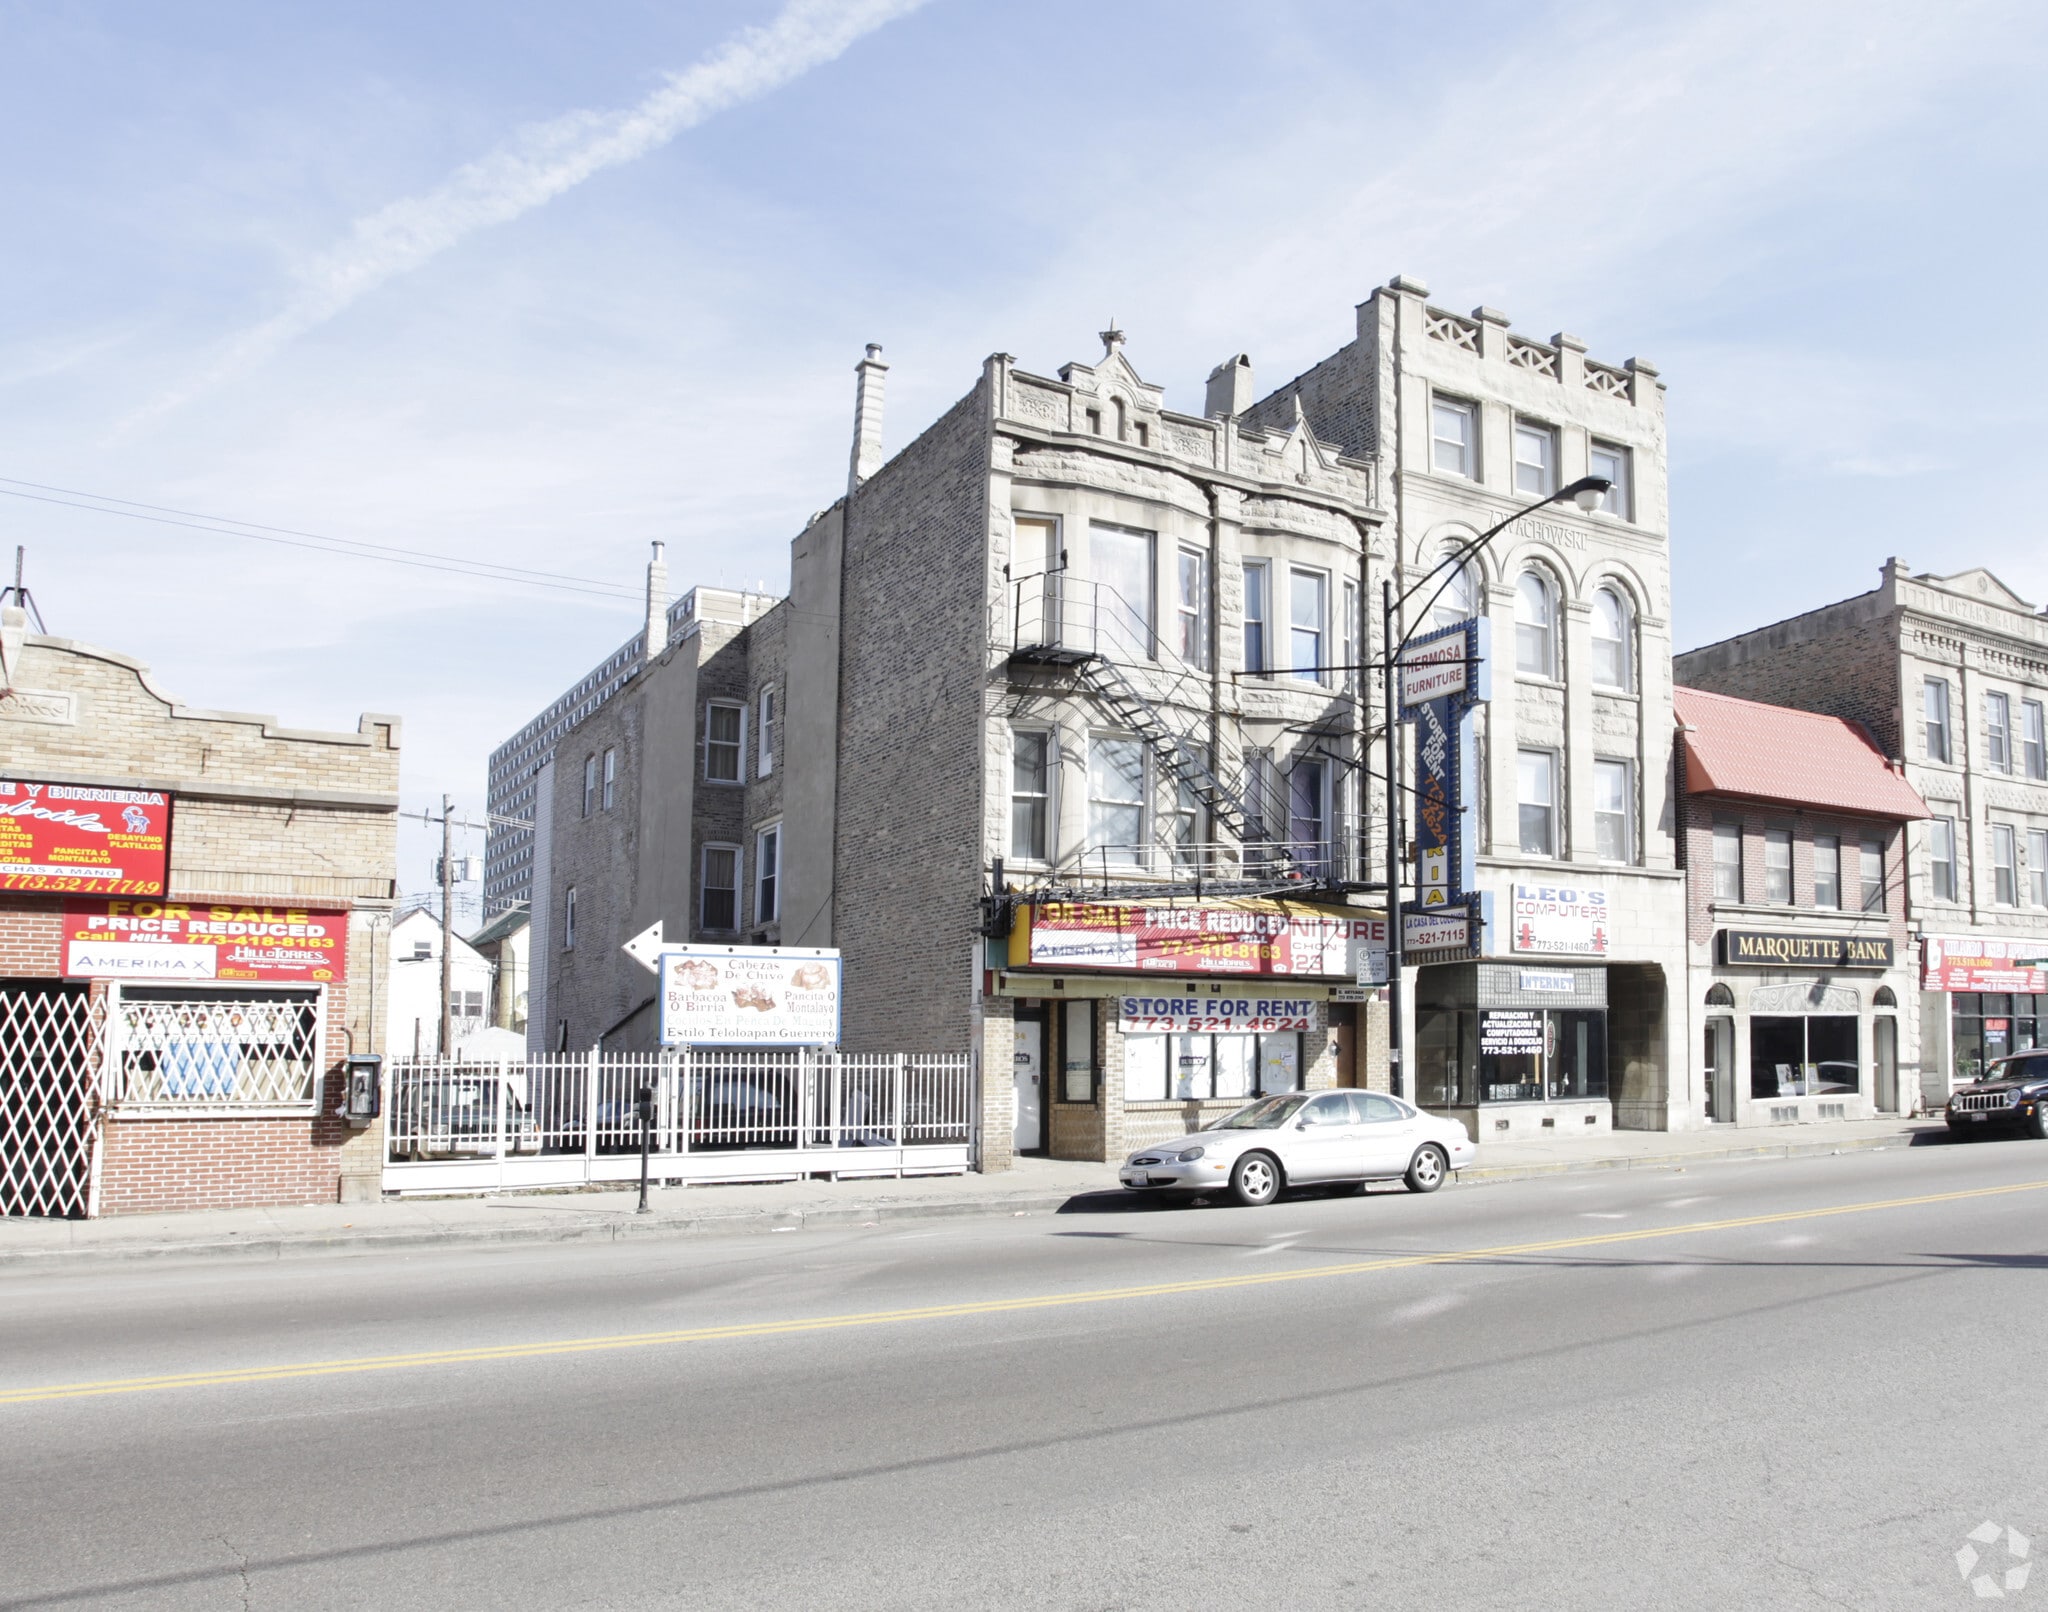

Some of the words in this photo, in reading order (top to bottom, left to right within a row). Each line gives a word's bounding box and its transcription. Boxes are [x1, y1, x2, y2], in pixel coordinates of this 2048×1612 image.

[1407, 645, 1461, 674] HERMOSA
[1407, 668, 1462, 696] FURNITURE
[1421, 702, 1447, 744] STORE
[1426, 735, 1445, 764] FOR
[1420, 746, 1445, 780] RENT
[24, 784, 44, 797] Y
[48, 786, 164, 805] BIRRIERIA
[107, 833, 162, 843] DESAYUNO
[110, 841, 164, 850] PLATILLOS
[48, 855, 111, 864] MONTALAYO
[54, 847, 98, 856] PANCITA
[4, 874, 160, 895] 773.521.7749
[1518, 886, 1605, 905] LEO'S
[108, 901, 191, 920] FOR
[208, 905, 309, 925] SALE
[1516, 902, 1607, 919] COMPUTERS
[88, 917, 180, 932] PRICE
[188, 921, 326, 937] REDUCED
[1082, 905, 1131, 926] SALE
[1144, 908, 1201, 930] PRICE
[1207, 912, 1289, 935] REDUCED
[1413, 916, 1428, 928] CASA
[75, 931, 116, 941] Call
[129, 933, 172, 943] HILL
[186, 934, 334, 948] 773-418-8163
[1036, 945, 1132, 962] AMERIMAX
[1160, 940, 1281, 959] 773-418-8163
[1739, 937, 1840, 962] MARQUETTE
[1846, 941, 1887, 960] BANK
[76, 956, 211, 975] AMERIMAX
[729, 959, 780, 970] Cabezas
[725, 971, 741, 979] De
[747, 970, 784, 980] Chivo
[1521, 976, 1573, 991] INTERNET
[668, 991, 727, 1002] Barbacoa
[785, 991, 824, 1001] Pancita
[670, 1002, 680, 1012] O
[686, 1001, 725, 1012] Birria
[1125, 998, 1198, 1015] STORE
[1206, 1000, 1250, 1016] FOR
[1256, 1000, 1312, 1016] RENT
[1124, 1016, 1310, 1032] 773.521.4624
[667, 1027, 705, 1038] Estilo
[709, 1027, 776, 1040] Teloloapan
[779, 1028, 835, 1039] Guerrero
